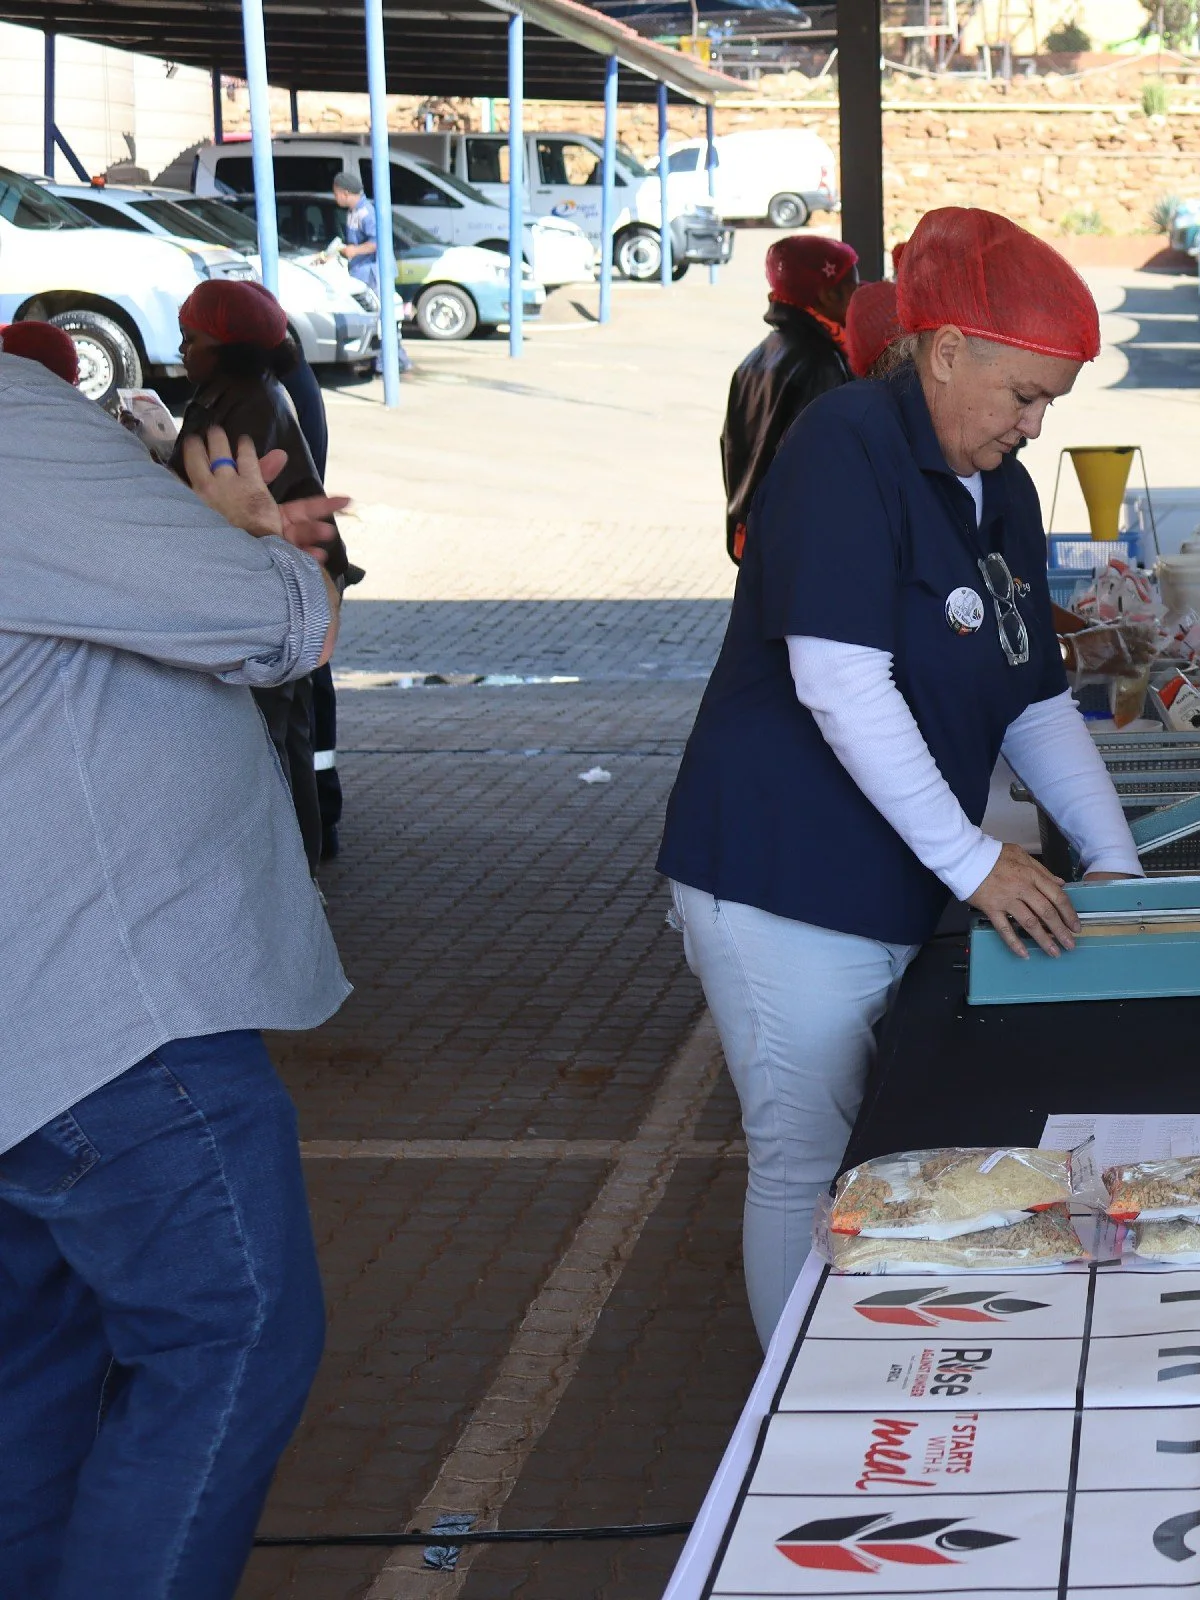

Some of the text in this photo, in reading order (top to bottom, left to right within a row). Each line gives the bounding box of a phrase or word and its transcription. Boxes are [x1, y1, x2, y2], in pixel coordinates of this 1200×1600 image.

[886, 1363, 903, 1382] AFRICA
[910, 1348, 934, 1397] AGAINST HUNGER
[930, 1347, 992, 1397] Rise
[855, 1418, 937, 1491] meal
[922, 1436, 947, 1475] WITH A
[945, 1424, 977, 1474] STARTS
